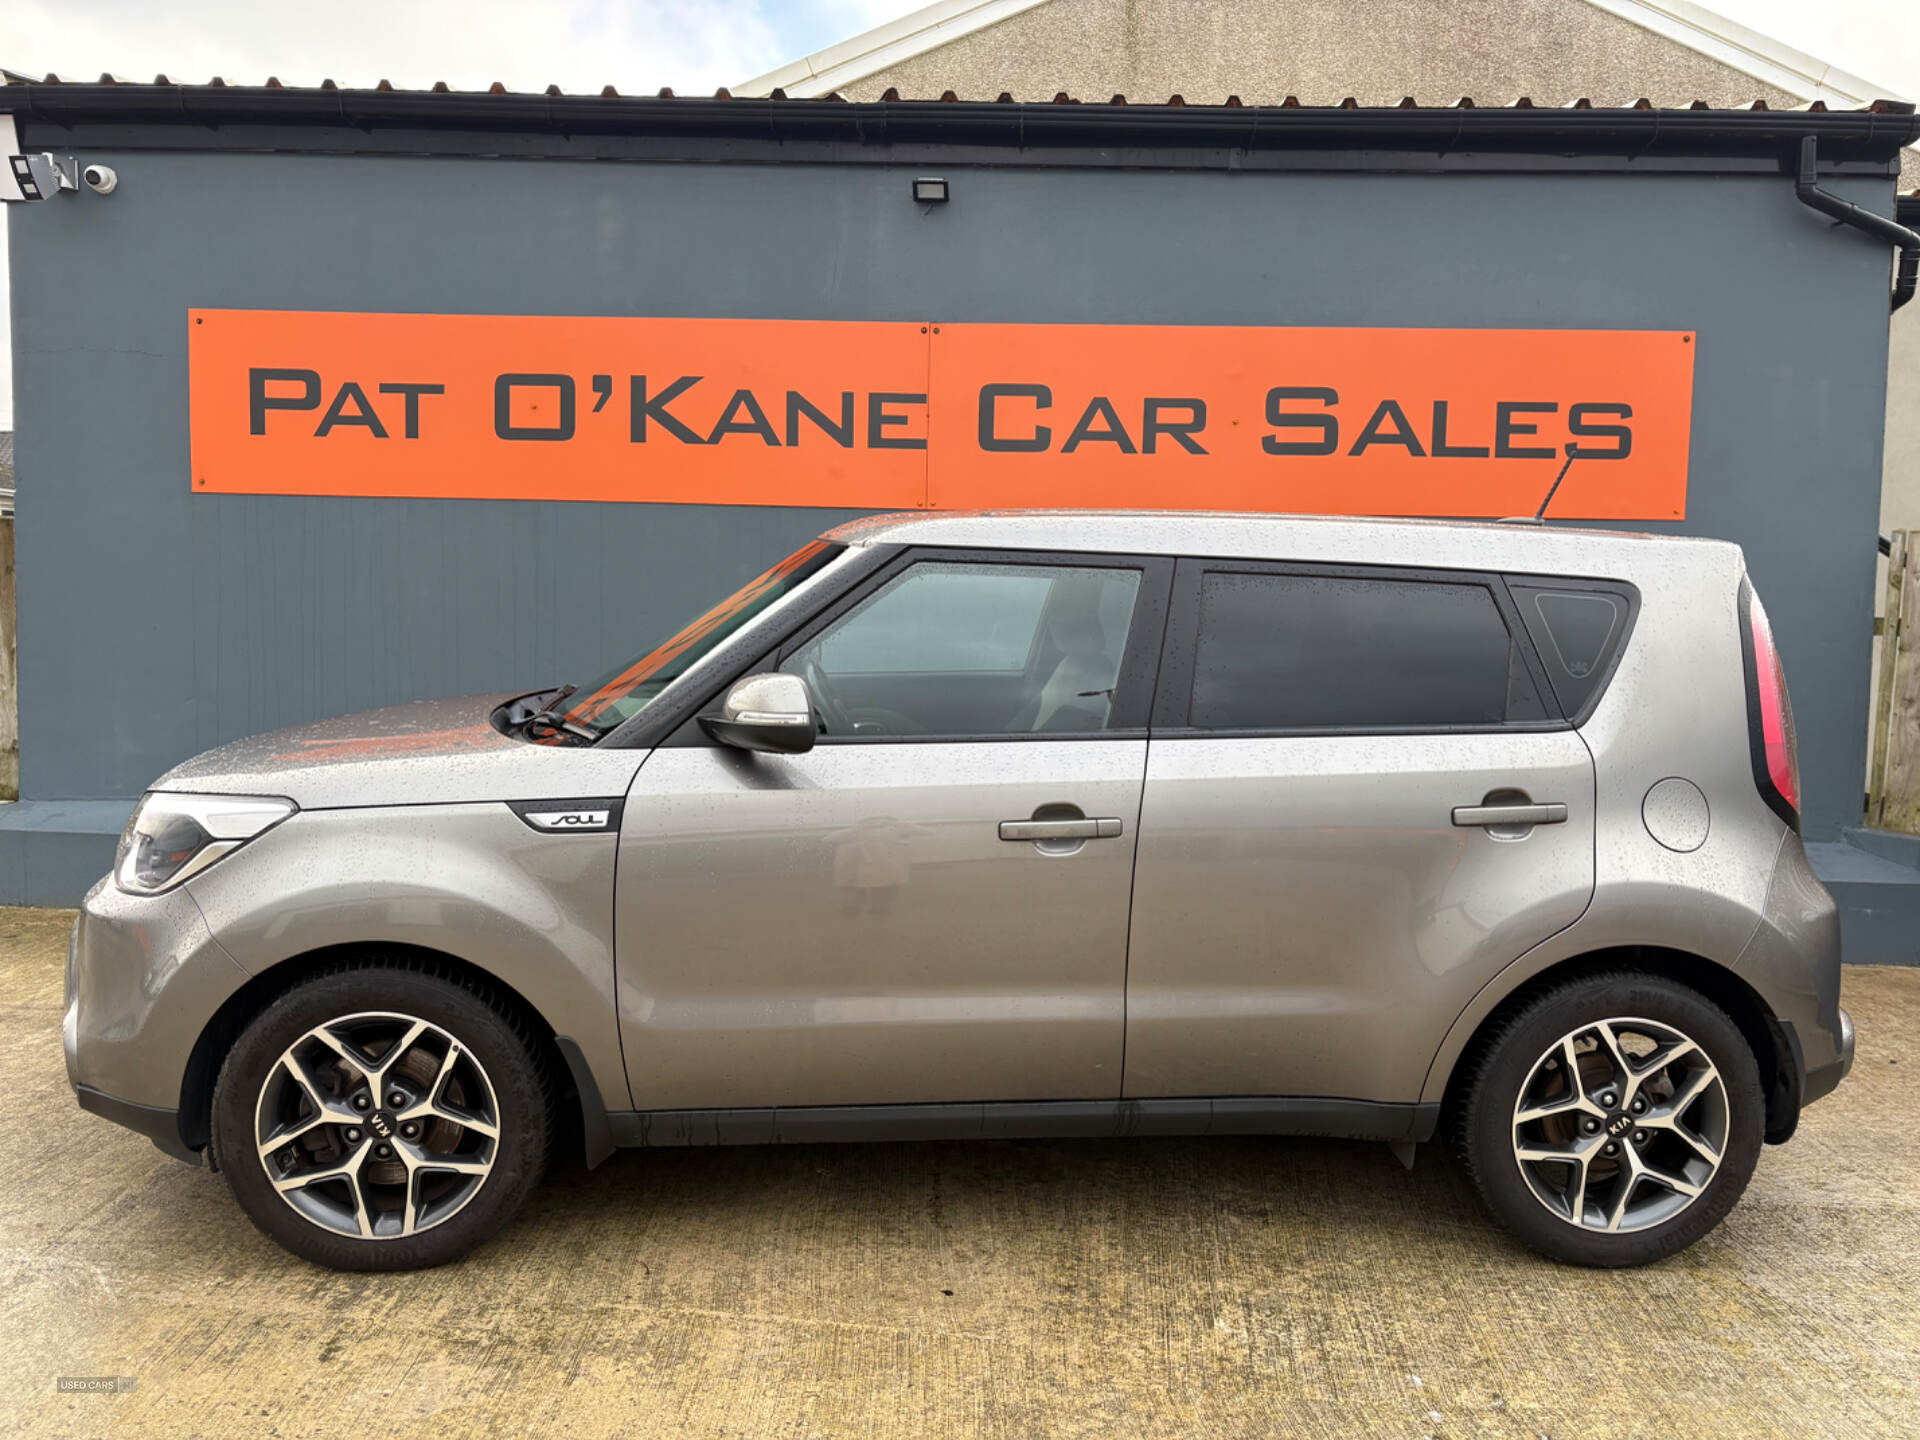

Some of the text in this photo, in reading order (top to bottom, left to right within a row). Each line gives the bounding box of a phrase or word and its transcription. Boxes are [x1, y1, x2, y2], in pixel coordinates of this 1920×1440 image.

[249, 367, 445, 440] PAT
[978, 383, 1210, 456] CAR
[1261, 386, 1633, 460] SALES
[551, 814, 604, 825] SOUL
[371, 1113, 391, 1137] KIA
[1609, 1116, 1631, 1135] KIA
